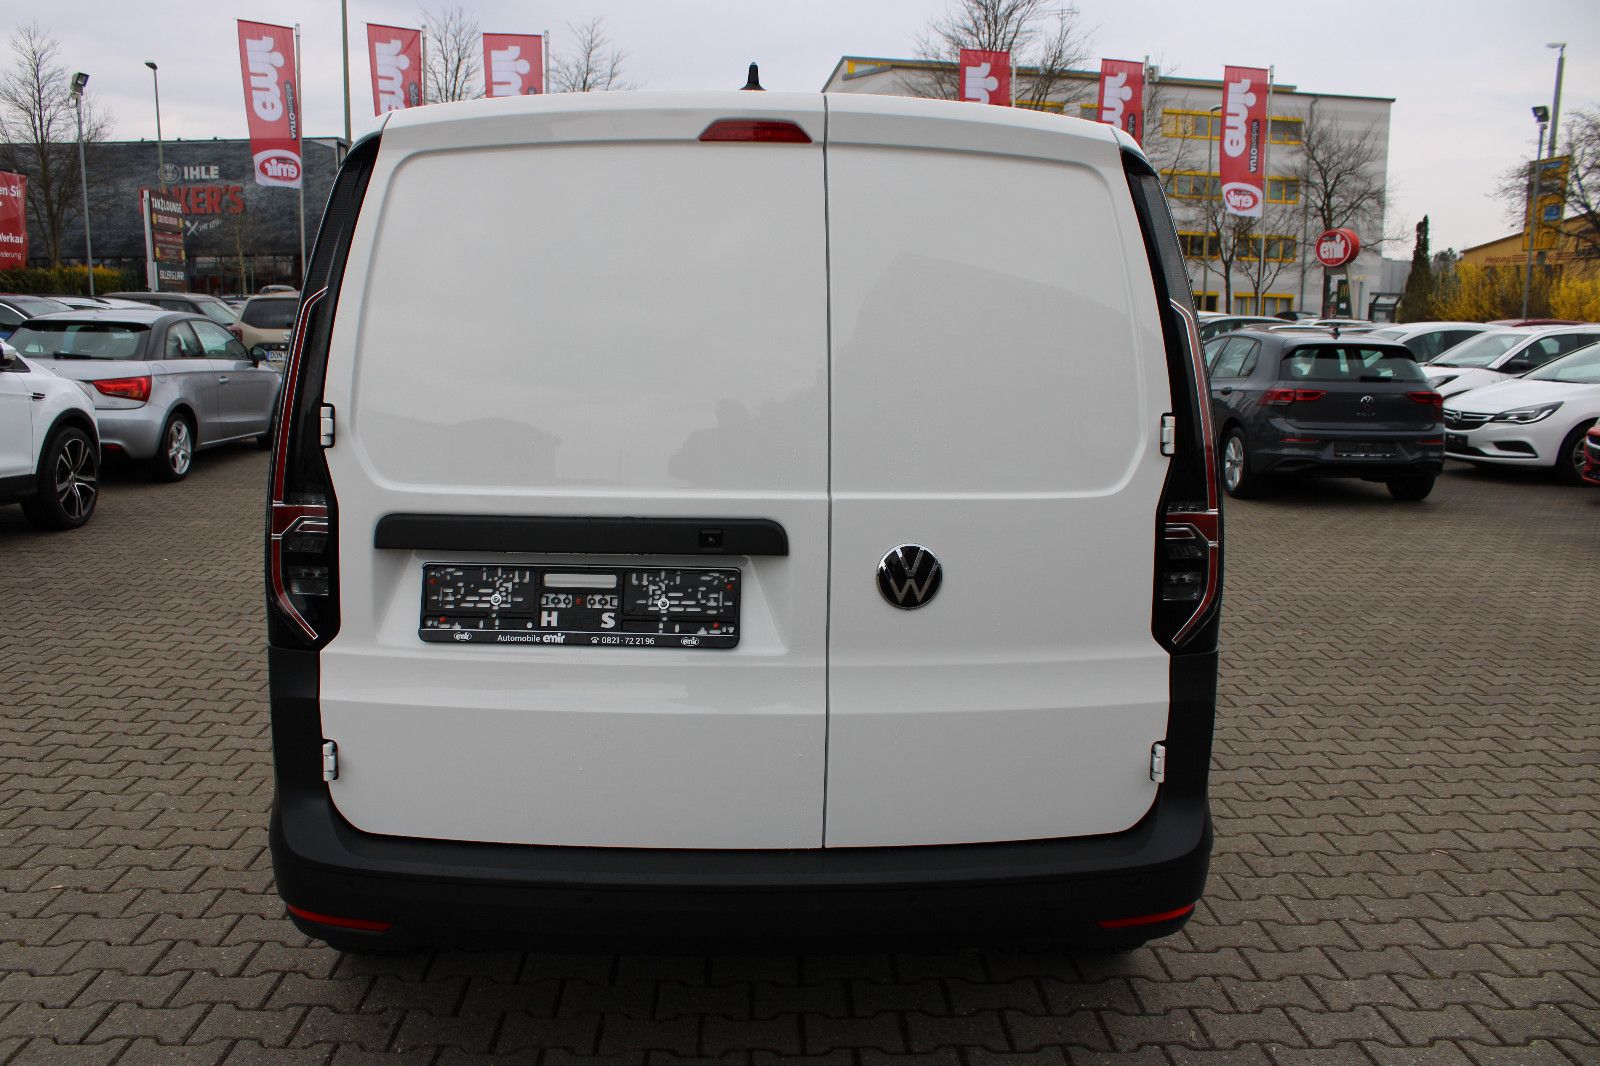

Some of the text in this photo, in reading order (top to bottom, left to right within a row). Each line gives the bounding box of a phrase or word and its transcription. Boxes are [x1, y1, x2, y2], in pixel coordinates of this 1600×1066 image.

[184, 166, 219, 179] IHLE
[1320, 234, 1345, 259] emir
[541, 611, 558, 627] H
[601, 612, 616, 629] S
[497, 634, 541, 643] Automobile
[542, 632, 566, 644] emir
